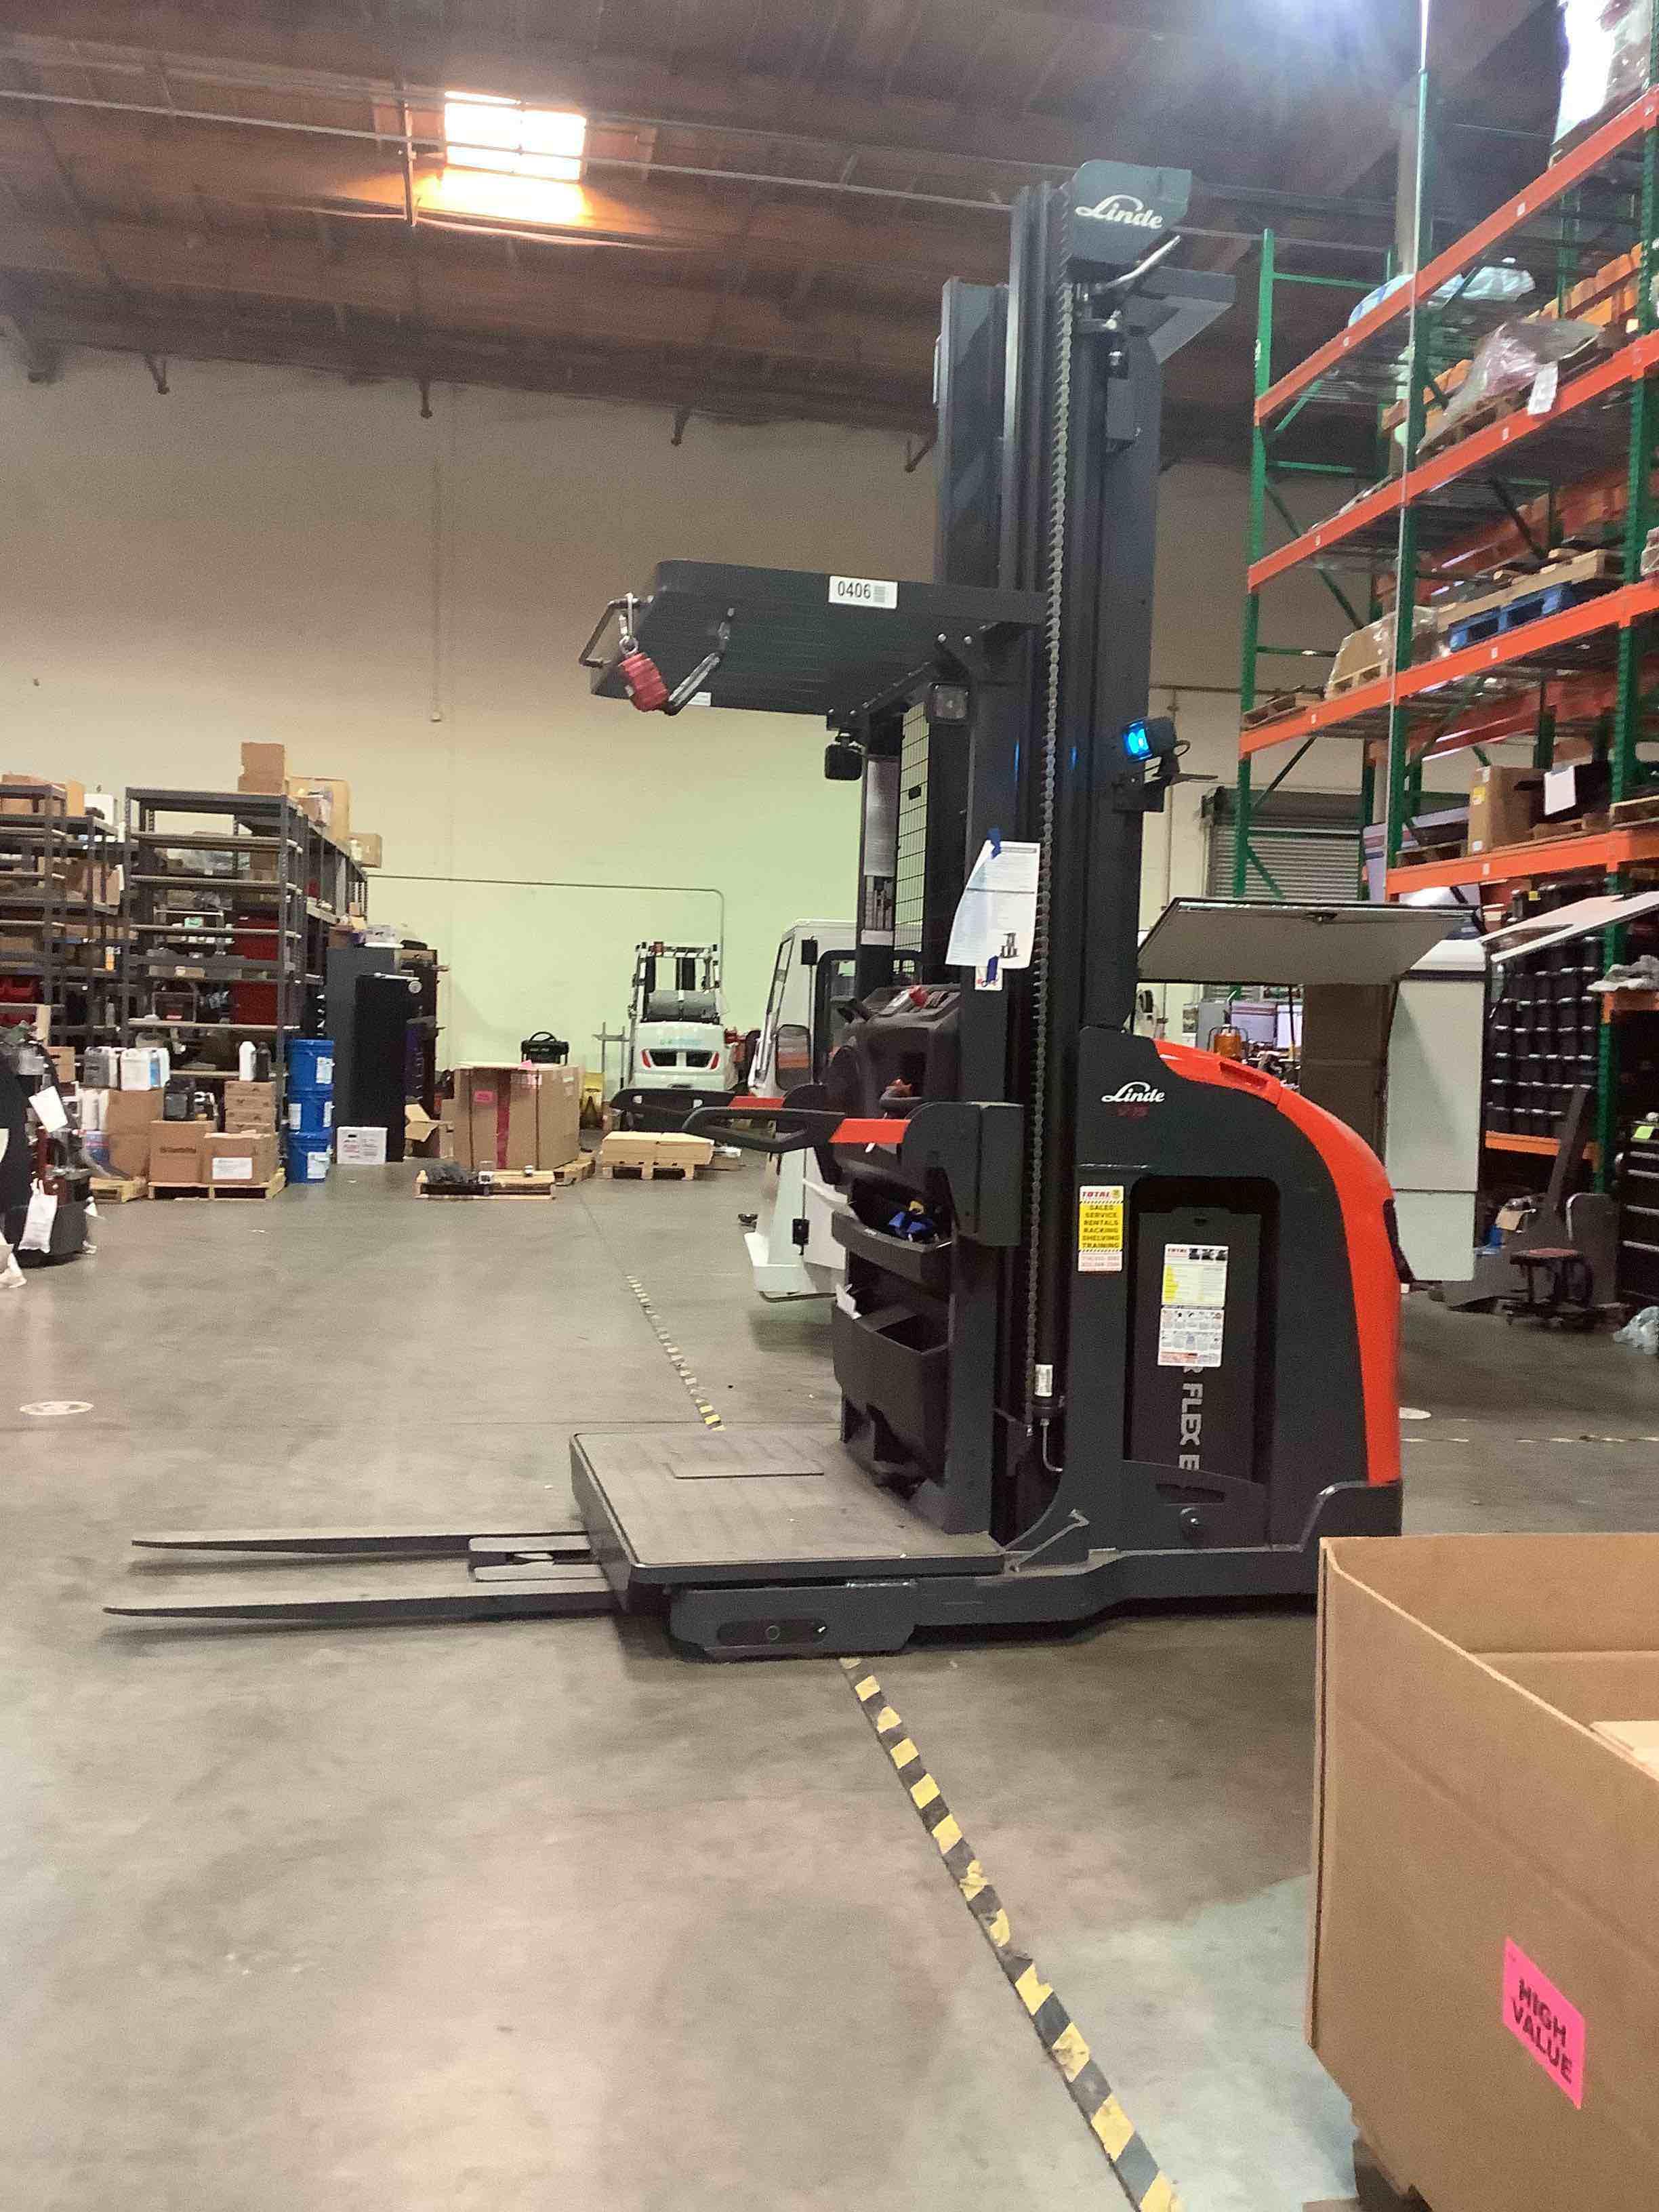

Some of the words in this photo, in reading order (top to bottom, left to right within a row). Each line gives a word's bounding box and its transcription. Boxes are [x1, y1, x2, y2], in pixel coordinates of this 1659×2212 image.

[1075, 194, 1164, 230] Linde
[837, 580, 872, 600] 0406
[1101, 1081, 1166, 1103] Linde
[1181, 1382, 1204, 1446] FLEX
[1519, 1978, 1568, 2047] HIGH
[1512, 1996, 1572, 2085] VALUE
